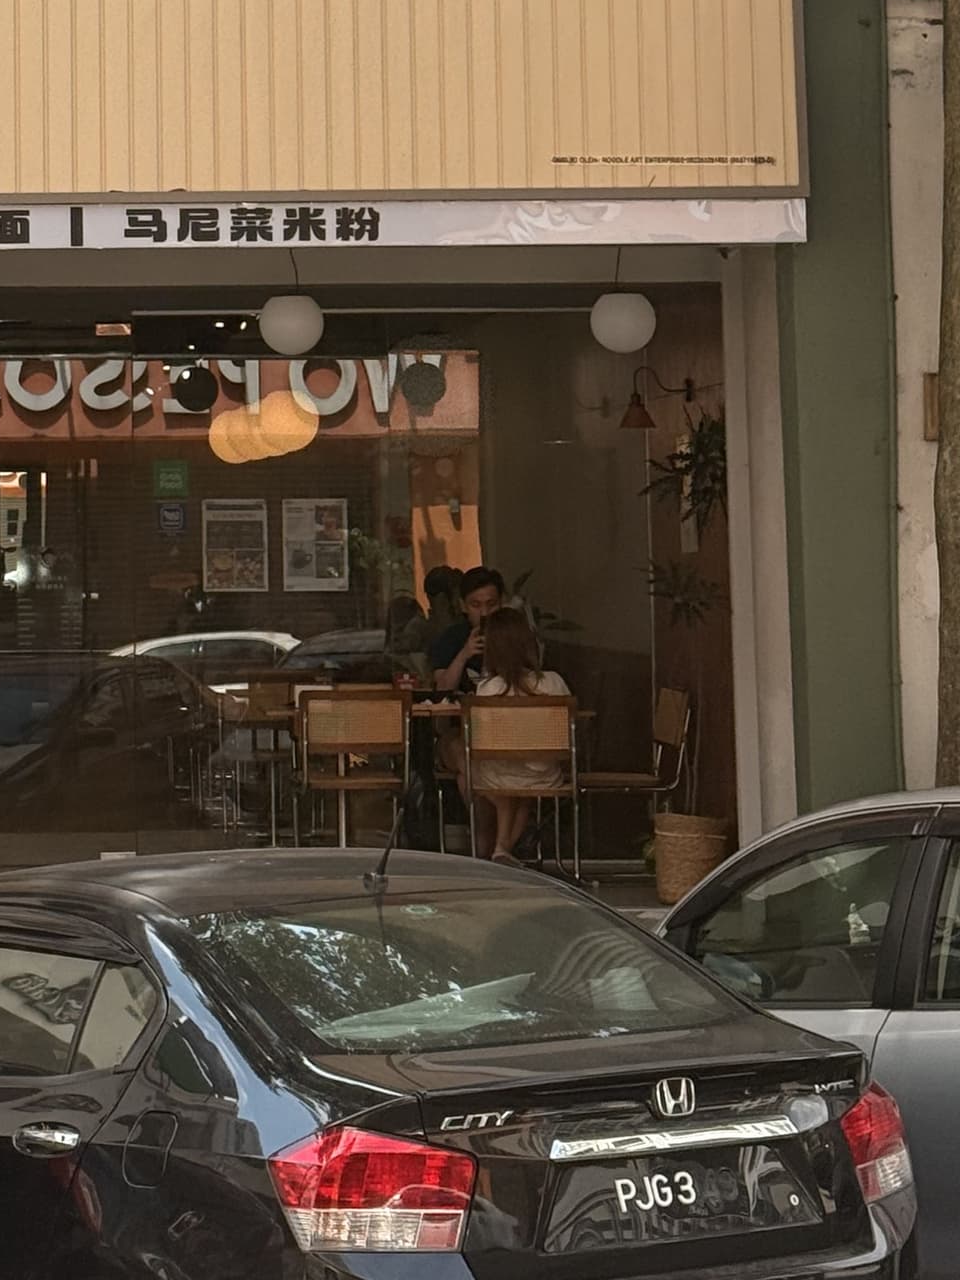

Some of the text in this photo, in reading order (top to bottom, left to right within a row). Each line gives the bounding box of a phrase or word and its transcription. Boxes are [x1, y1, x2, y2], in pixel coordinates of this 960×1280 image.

[123, 206, 381, 243] 马尼菜米粉
[440, 1110, 515, 1131] CITY
